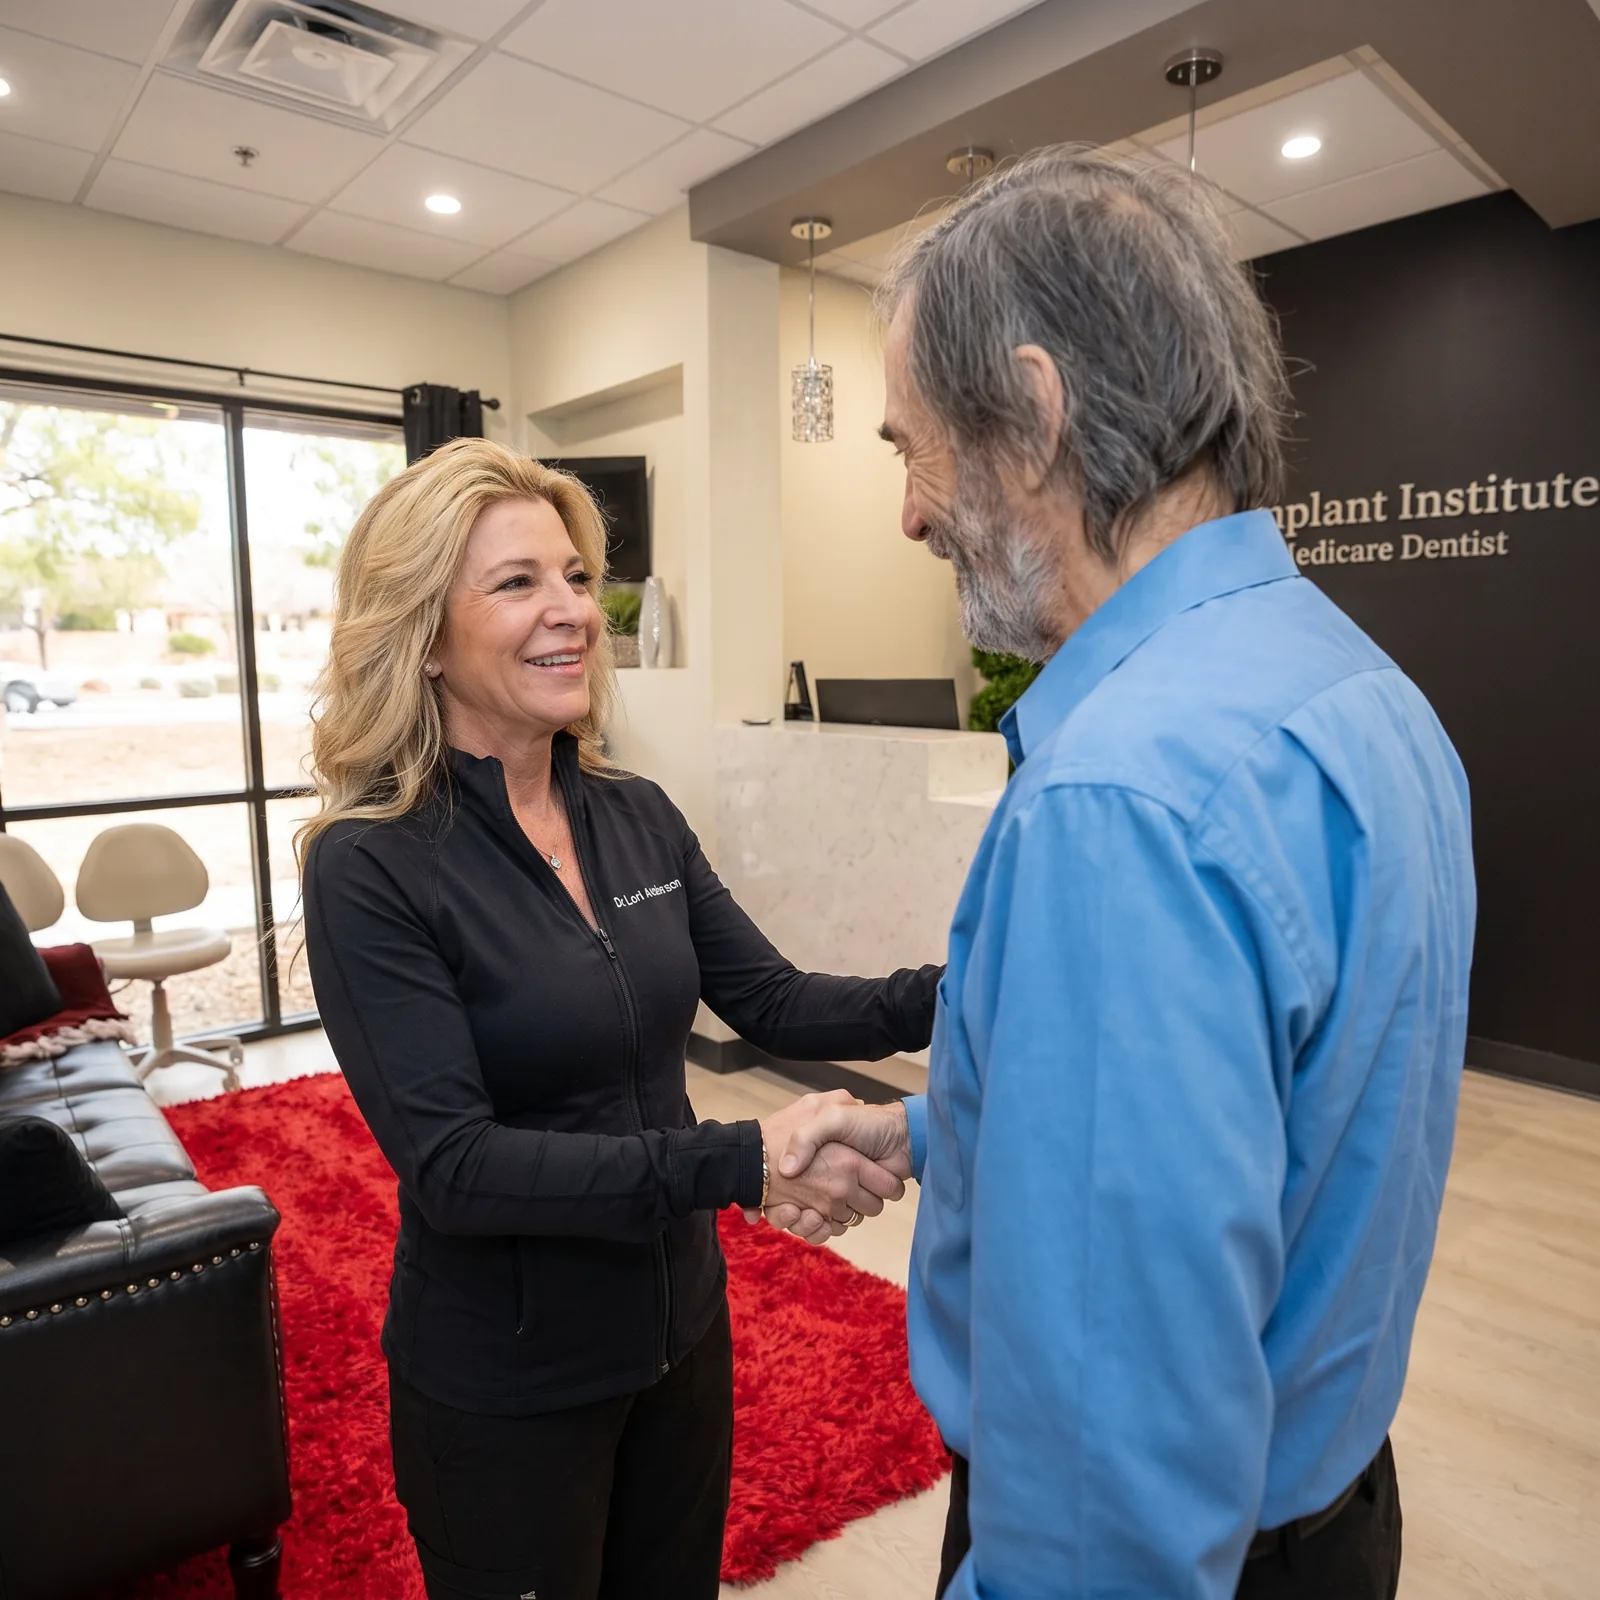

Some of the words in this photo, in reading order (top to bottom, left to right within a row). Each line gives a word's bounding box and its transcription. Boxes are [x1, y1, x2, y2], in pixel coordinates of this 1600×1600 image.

[1398, 472, 1600, 521] Institute
[1288, 540, 1394, 566] edicare
[1400, 529, 1509, 561] Dentist
[623, 890, 645, 906] Lori
